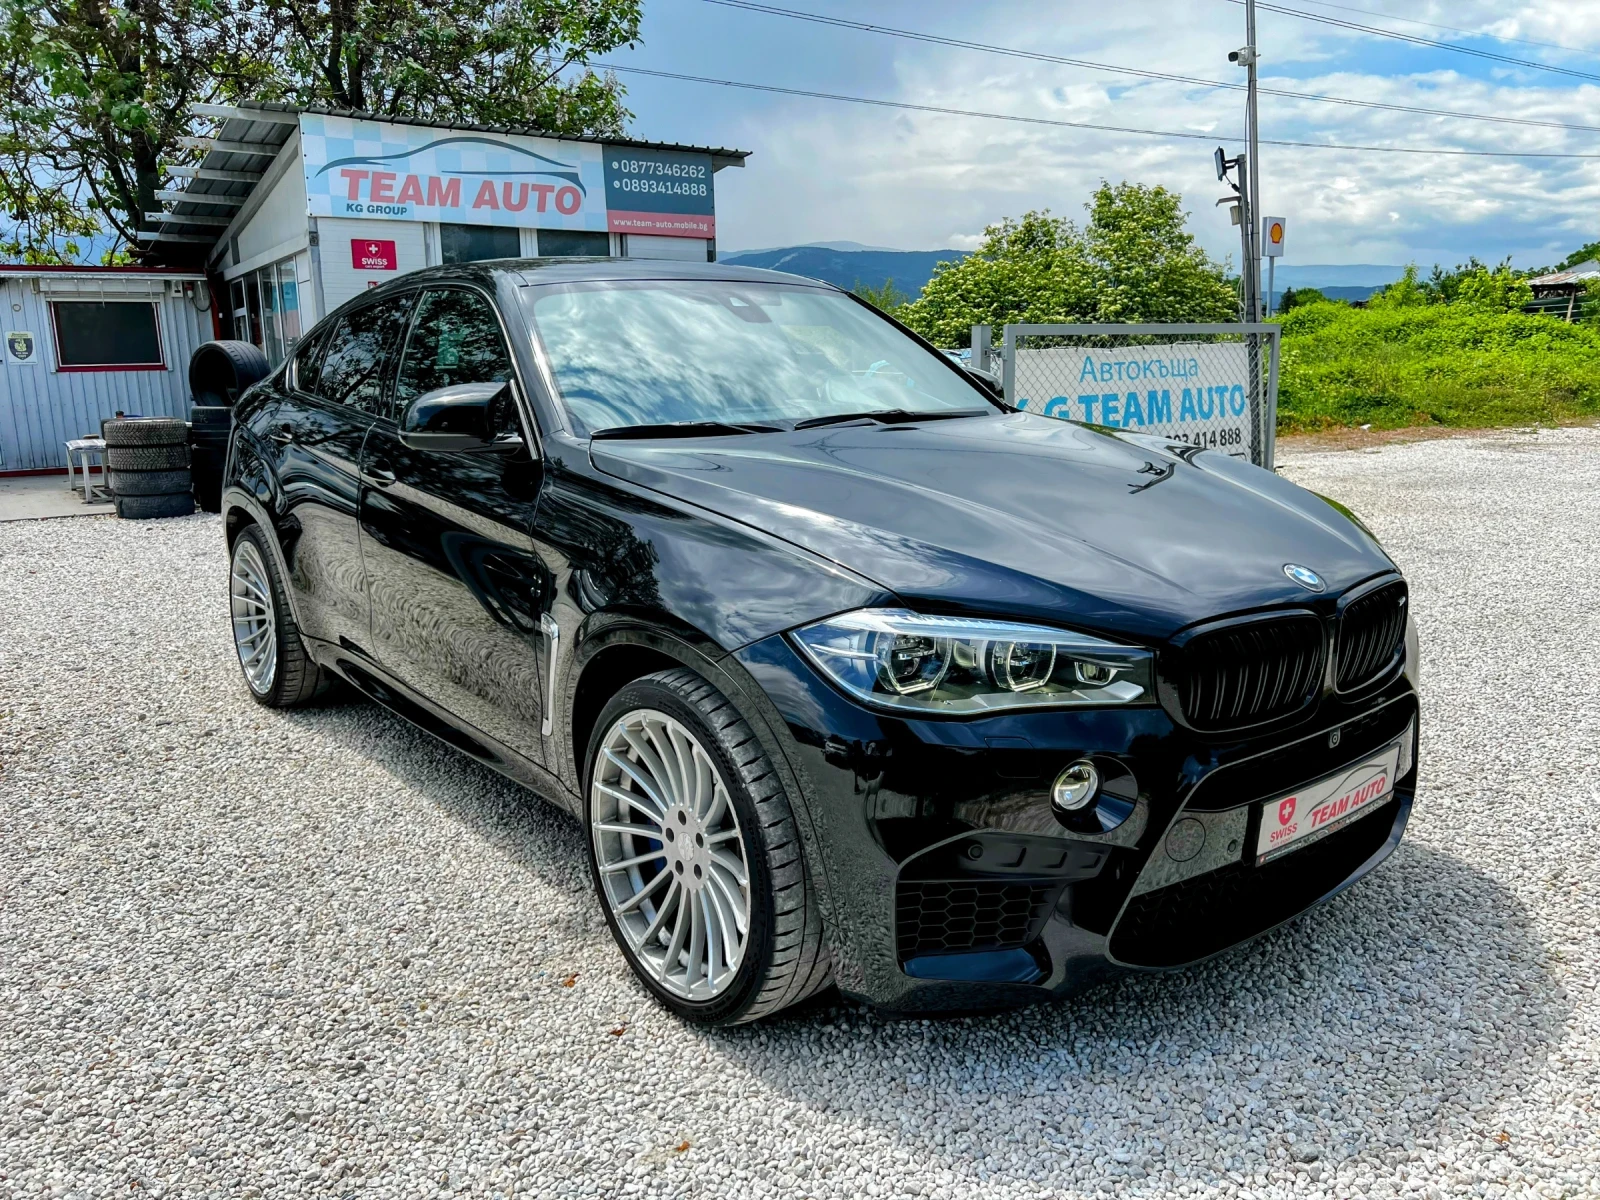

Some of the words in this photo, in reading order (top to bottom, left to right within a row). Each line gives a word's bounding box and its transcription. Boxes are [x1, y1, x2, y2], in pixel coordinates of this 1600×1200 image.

[621, 160, 705, 178] 0877346262
[340, 168, 461, 209] TEAM
[474, 178, 582, 215] AUTO
[622, 179, 707, 196] 0893414888
[346, 203, 364, 213] KG
[367, 204, 407, 216] GROUP
[613, 219, 708, 231] www.team-auto.mobile.bg
[361, 258, 388, 266] SWISS
[1080, 355, 1199, 383] Автокъща
[1078, 389, 1172, 427] TEAM
[1180, 384, 1246, 421] AUTO
[1194, 431, 1217, 448] 414
[1220, 427, 1241, 446] 888
[1311, 795, 1350, 828] TEAM
[1351, 776, 1386, 808] AUTO
[1270, 823, 1297, 843] SWISS
